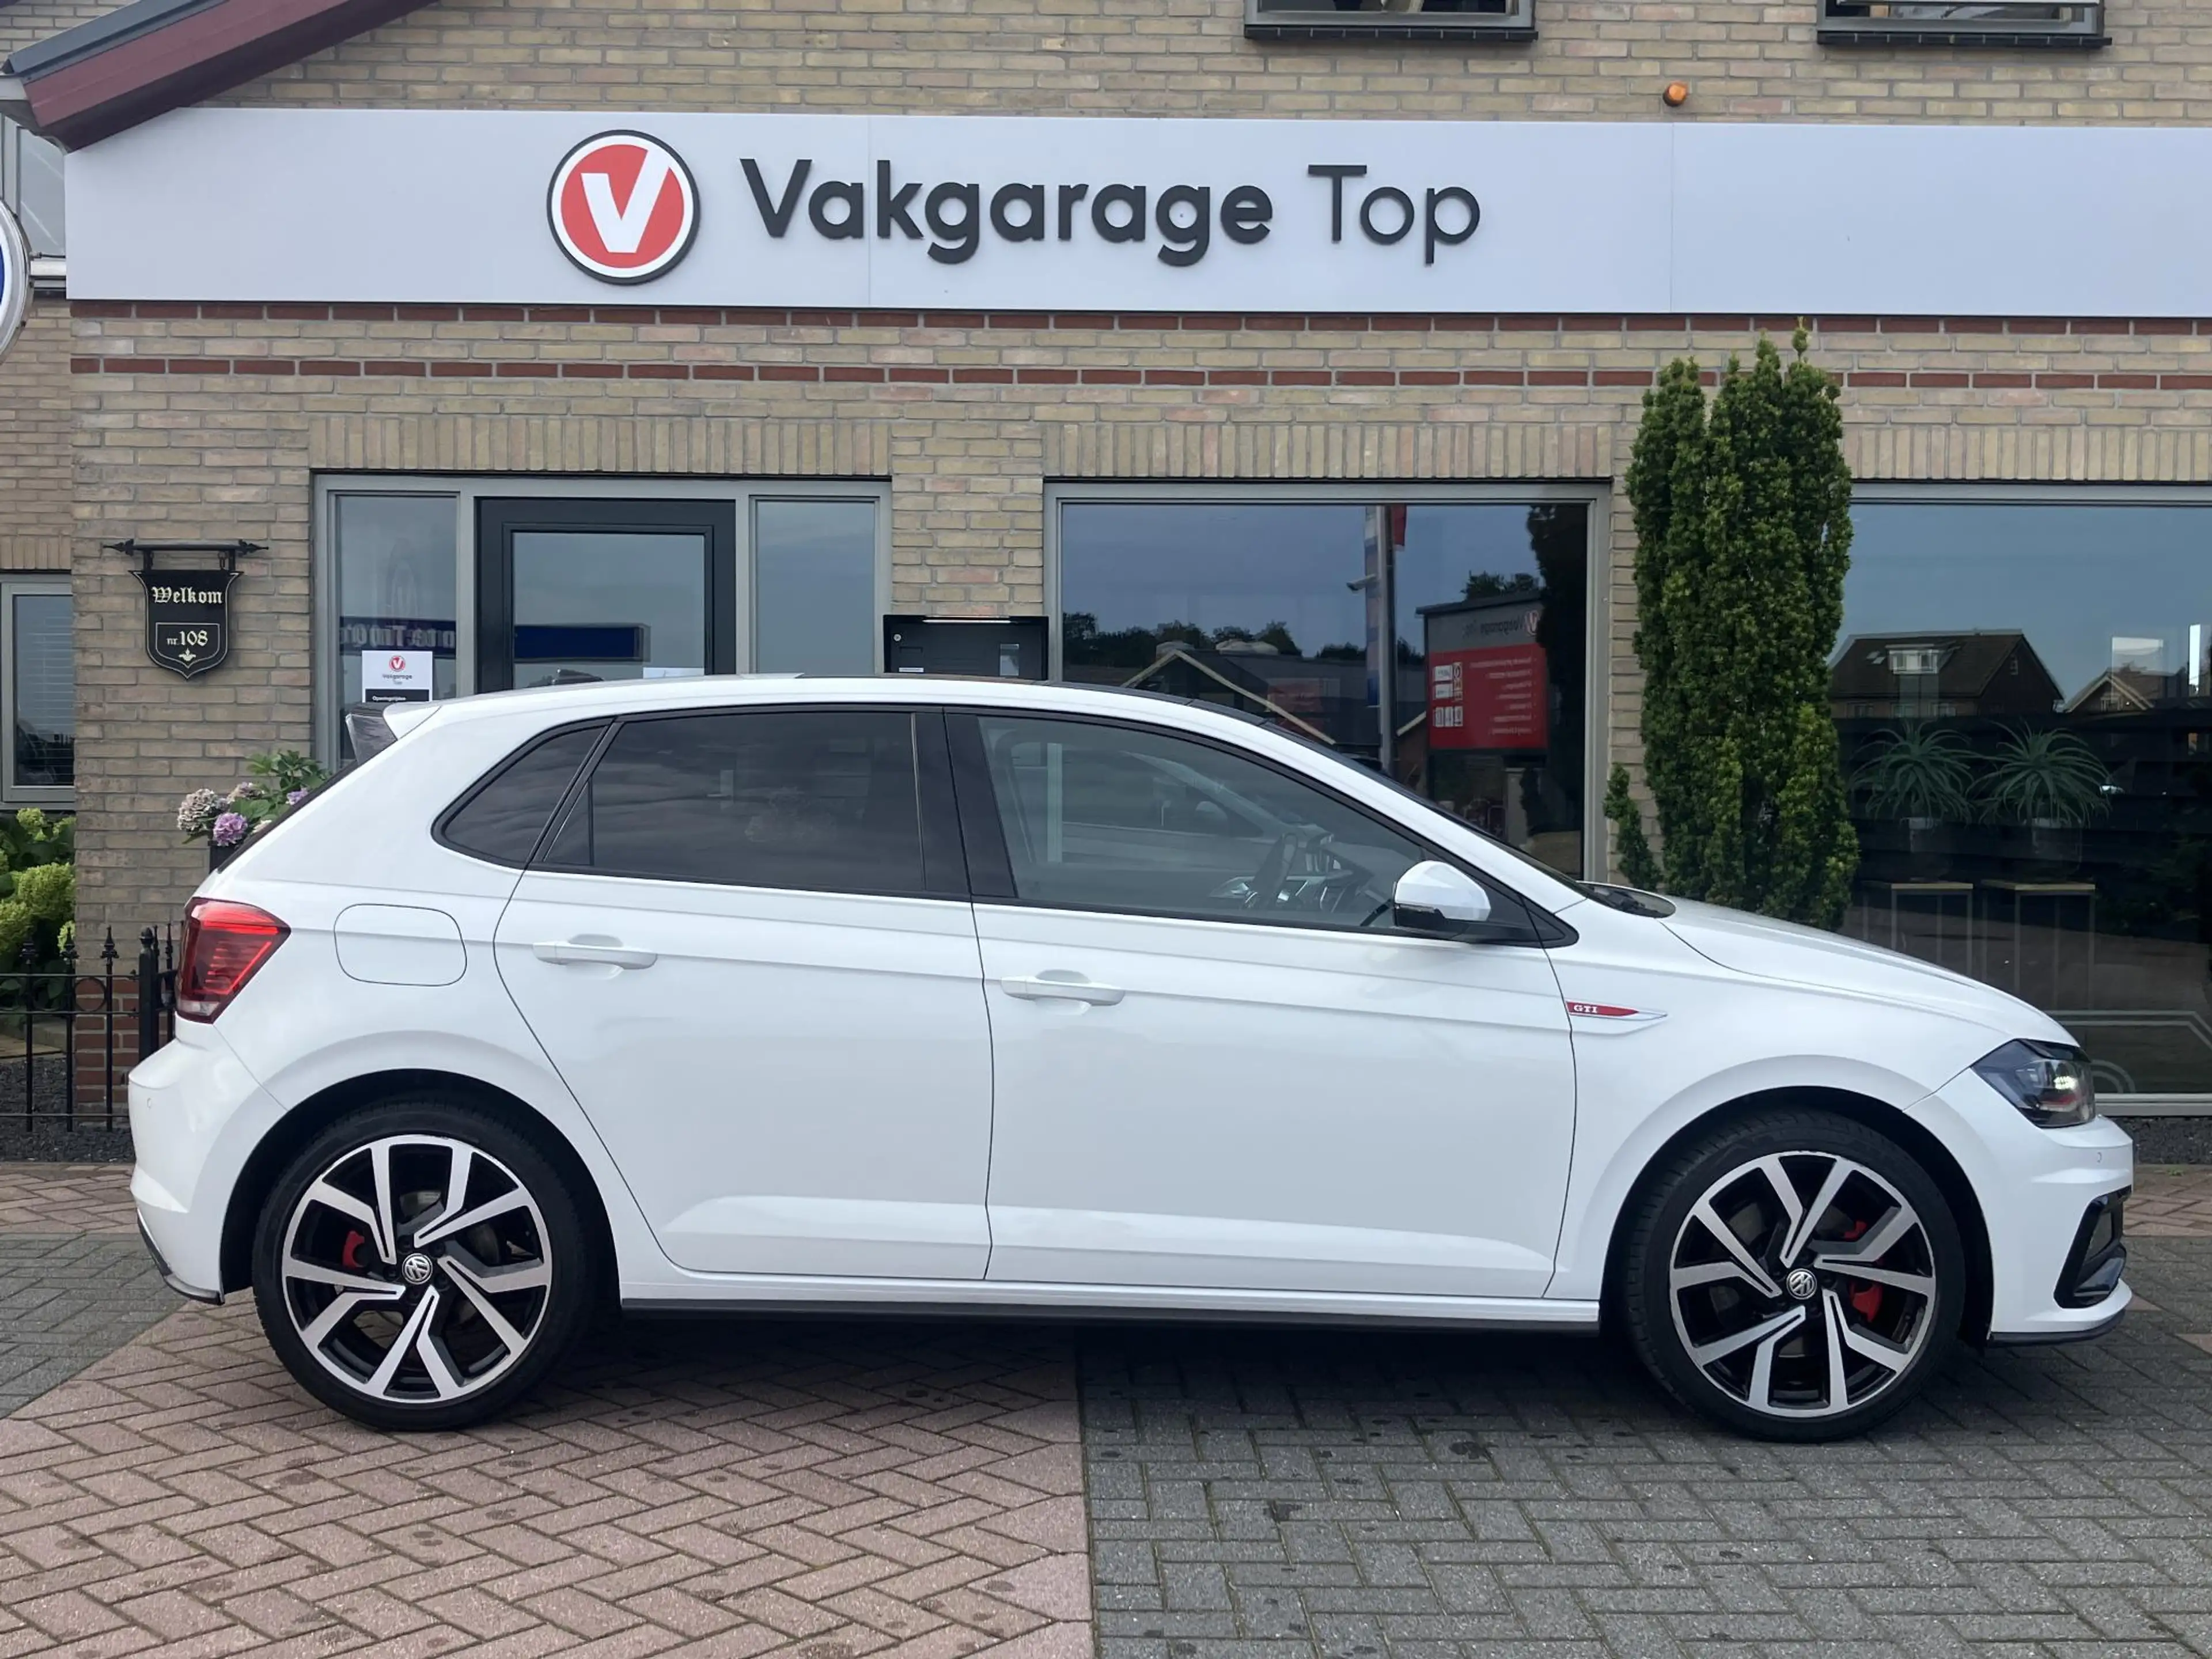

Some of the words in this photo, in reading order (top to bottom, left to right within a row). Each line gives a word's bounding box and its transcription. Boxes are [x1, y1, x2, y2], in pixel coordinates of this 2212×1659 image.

[740, 158, 1274, 267] Vakgarage
[1307, 164, 1481, 266] Top
[151, 586, 222, 604] Welkom
[1573, 1004, 1598, 1013] GTI
